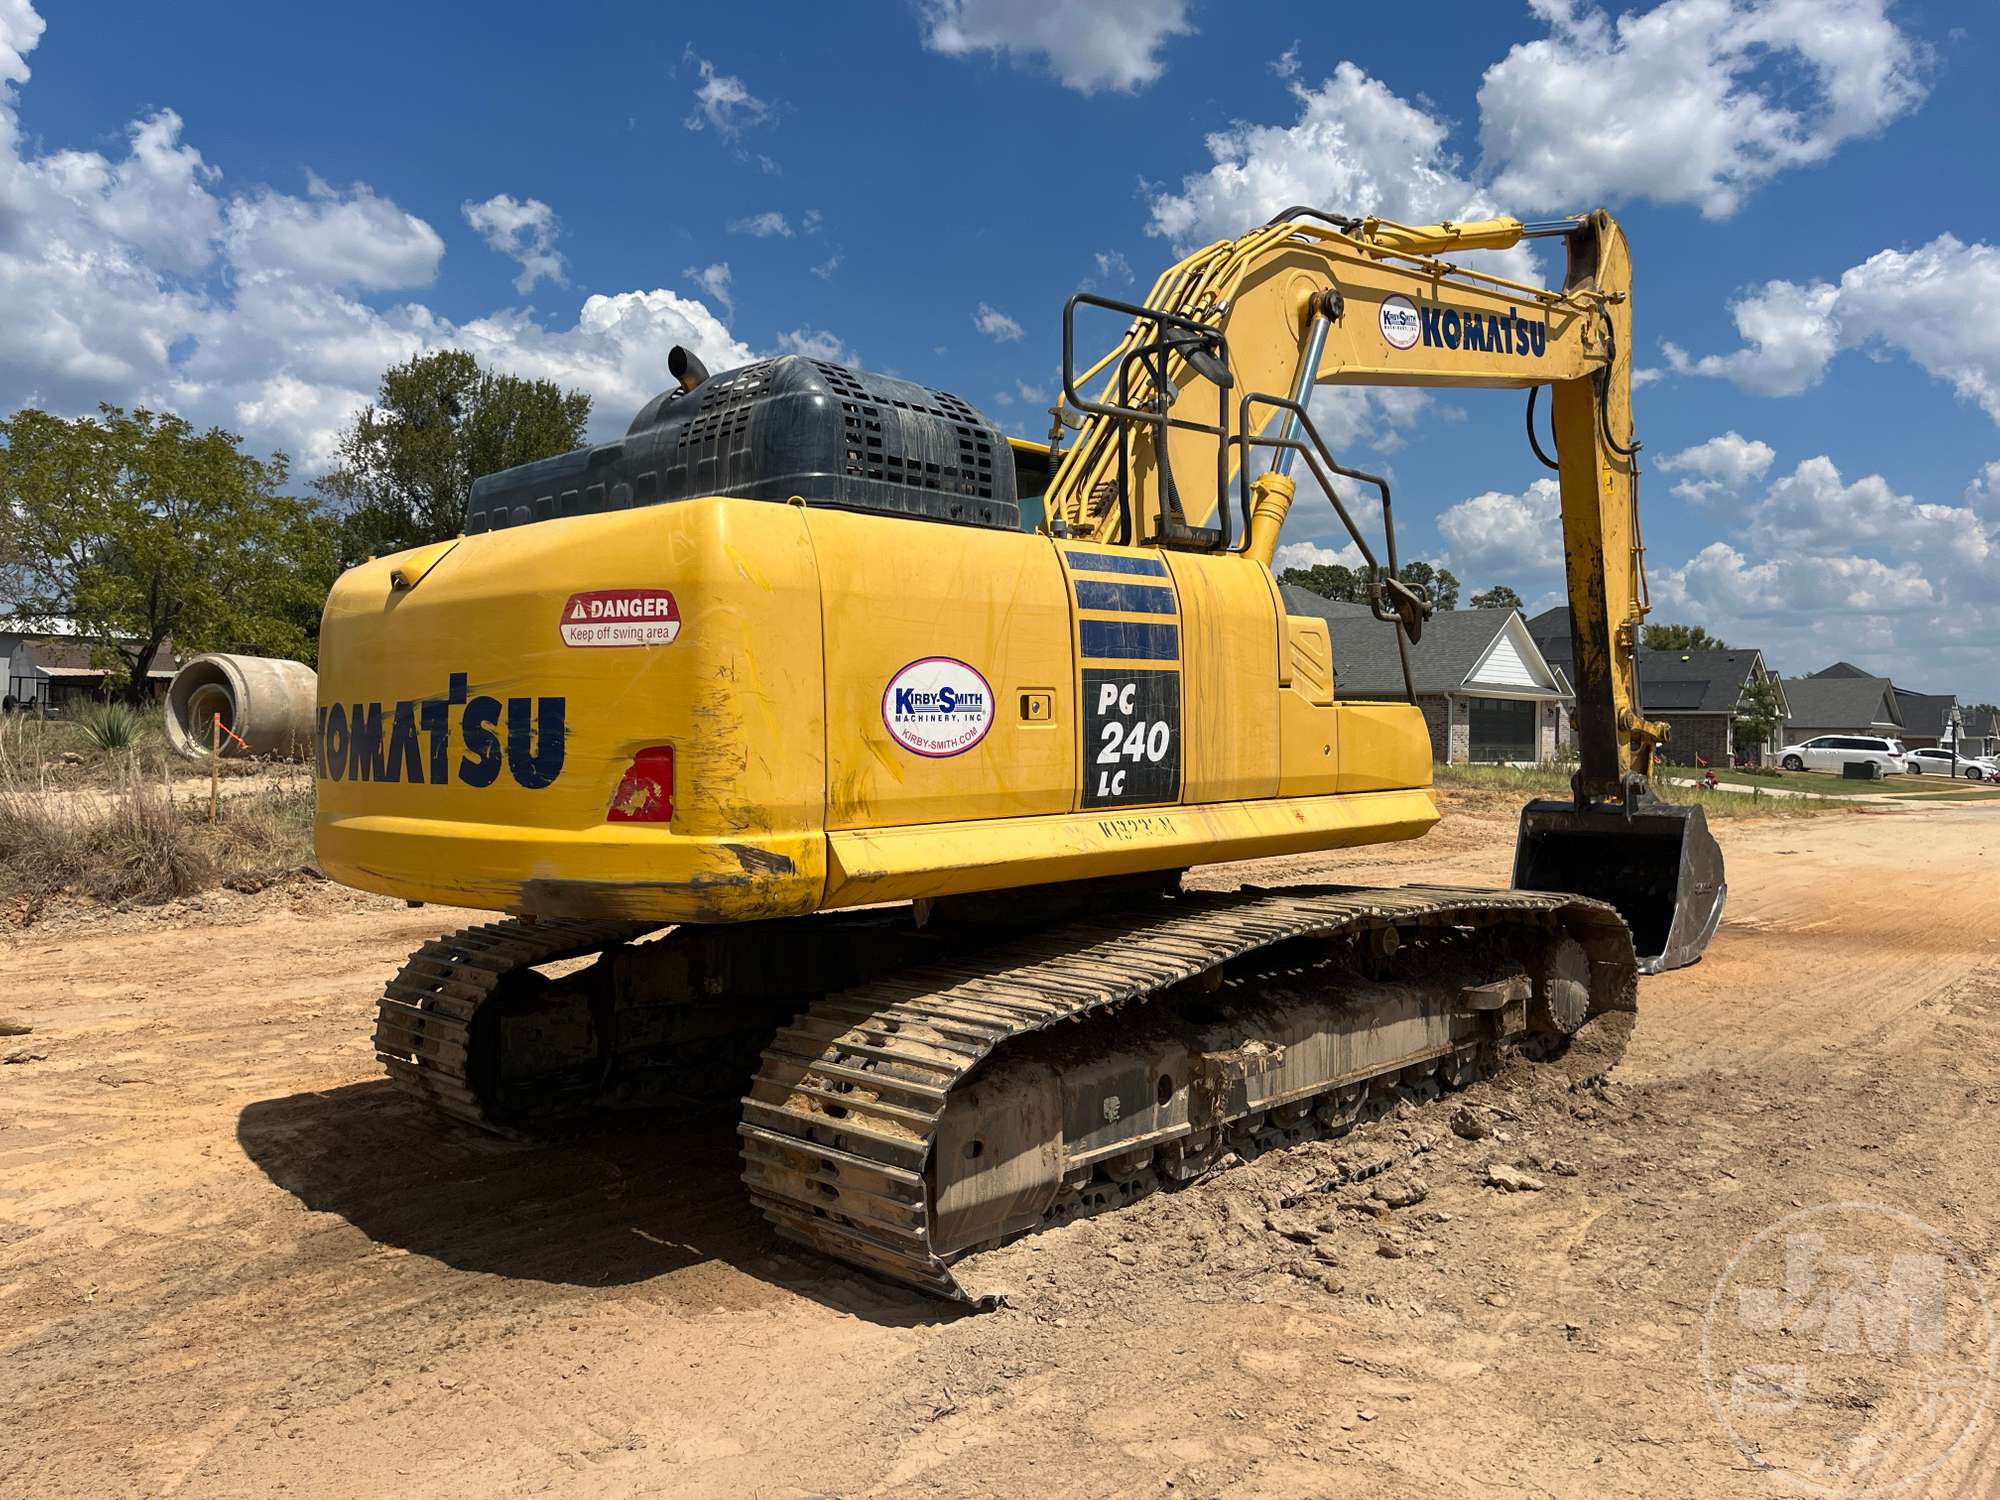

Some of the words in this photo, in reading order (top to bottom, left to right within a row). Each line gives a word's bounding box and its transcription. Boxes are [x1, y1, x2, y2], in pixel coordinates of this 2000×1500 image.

[1421, 306, 1546, 358] KOMATSU
[591, 598, 669, 618] DANGER
[570, 628, 594, 642] Keep
[597, 627, 611, 640] off
[613, 627, 644, 642] swing
[646, 627, 669, 639] area
[895, 686, 983, 715] KIRBY-SMITH
[1097, 683, 1137, 715] PC
[895, 714, 960, 723] MACHINERY,
[901, 726, 978, 750] KIRBY-SMITH.COM
[1096, 721, 1171, 764] 240
[1097, 770, 1127, 797] LC
